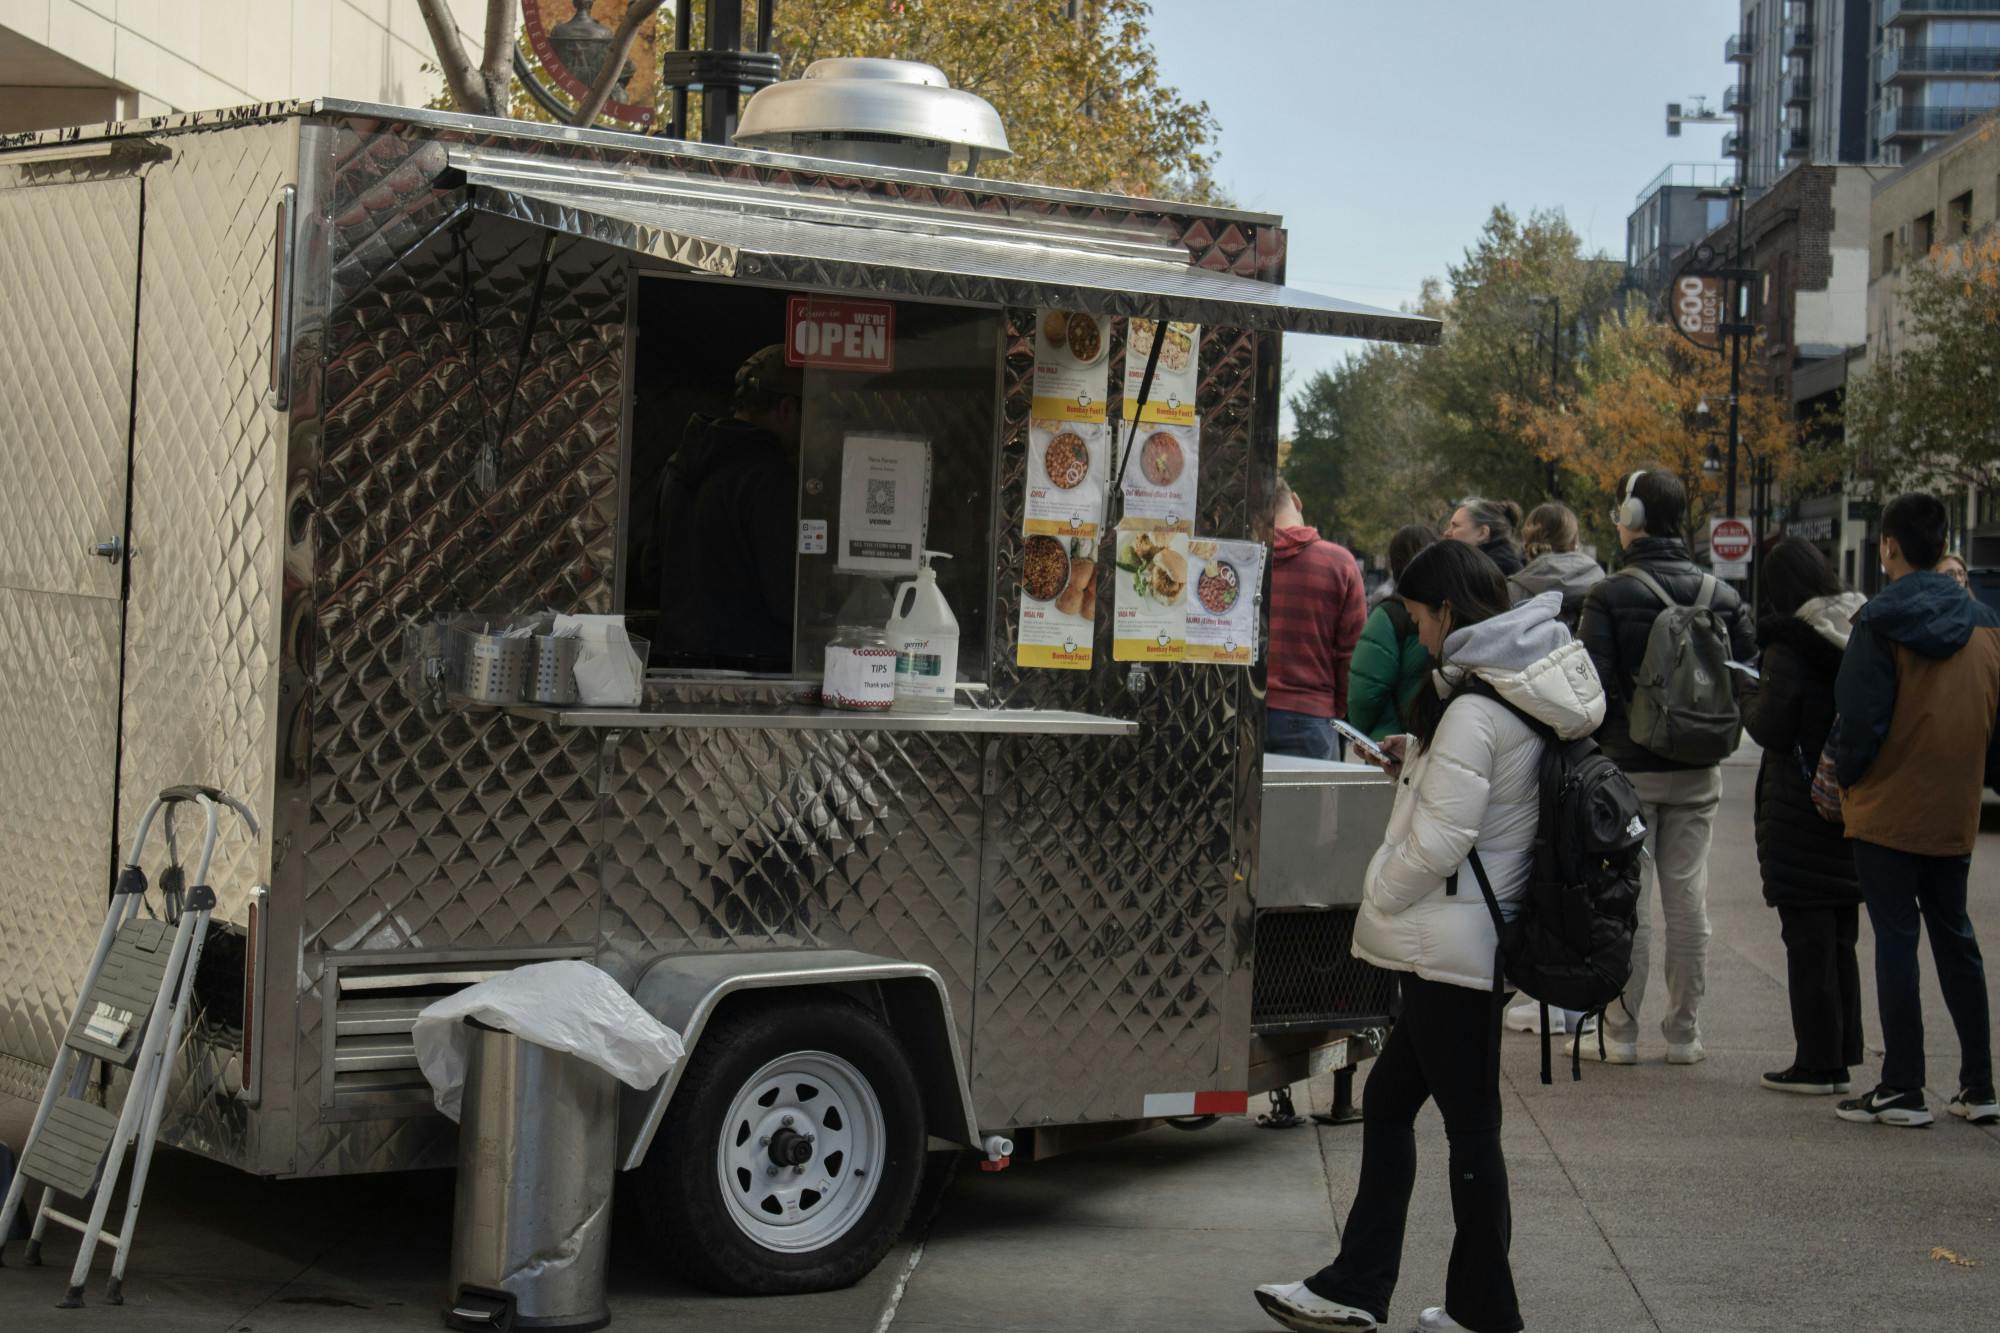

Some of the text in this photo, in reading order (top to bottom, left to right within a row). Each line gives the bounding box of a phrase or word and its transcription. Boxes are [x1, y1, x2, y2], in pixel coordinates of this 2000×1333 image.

[1680, 277, 1703, 332] 600
[1703, 288, 1717, 333] BLOCK
[853, 312, 887, 325] WE'RE
[795, 320, 886, 360] OPEN
[1066, 405, 1088, 414] Bombay
[1156, 407, 1177, 416] Bombay
[1718, 528, 1744, 536] DO NOT
[1718, 546, 1744, 554] ENTER
[1147, 645, 1168, 654] Bombay
[1052, 652, 1074, 661] Bombay
[871, 664, 888, 673] TIPS
